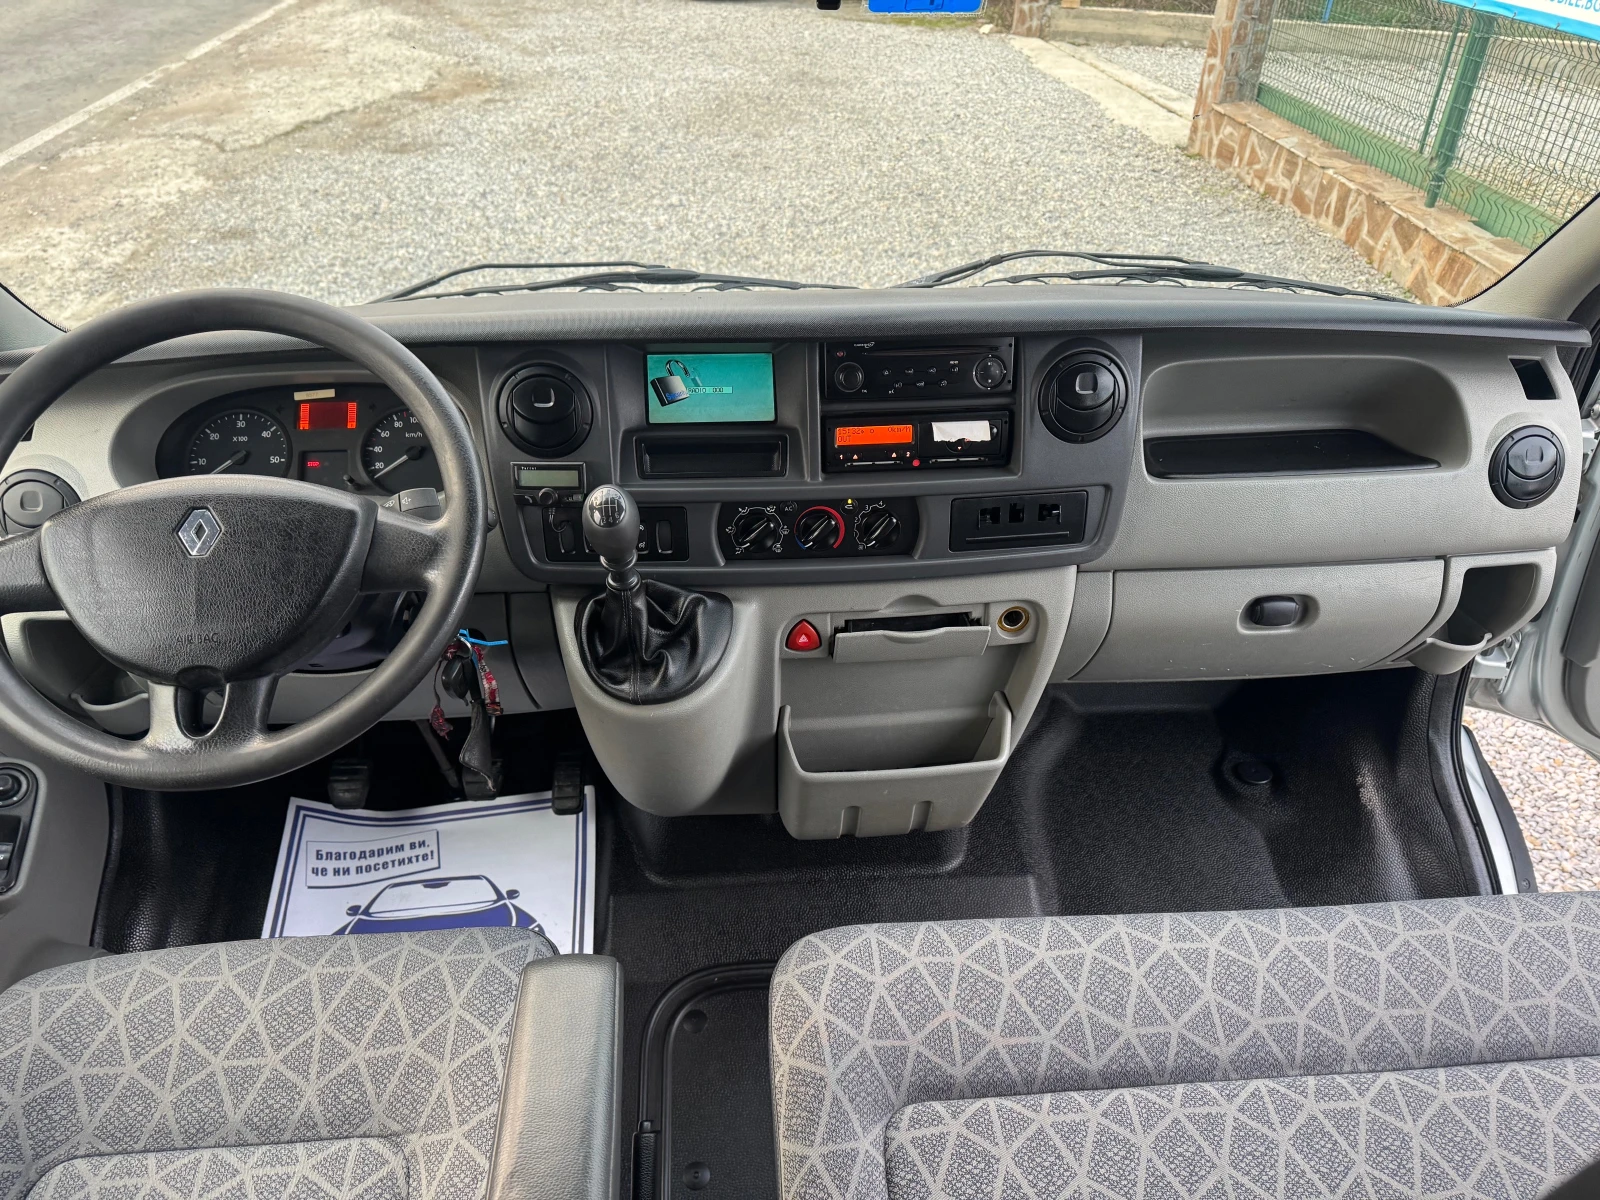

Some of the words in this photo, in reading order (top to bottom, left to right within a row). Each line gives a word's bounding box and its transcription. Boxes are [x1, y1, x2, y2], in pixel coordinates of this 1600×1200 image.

[236, 420, 246, 428] 30
[409, 416, 419, 424] 10
[209, 432, 220, 440] 20
[261, 430, 271, 438] 40
[380, 430, 390, 438] 60
[373, 445, 383, 453] 40
[315, 843, 405, 861] Благодарим
[311, 866, 328, 877] че
[333, 866, 351, 876] ни
[355, 850, 435, 875] посетихте!
